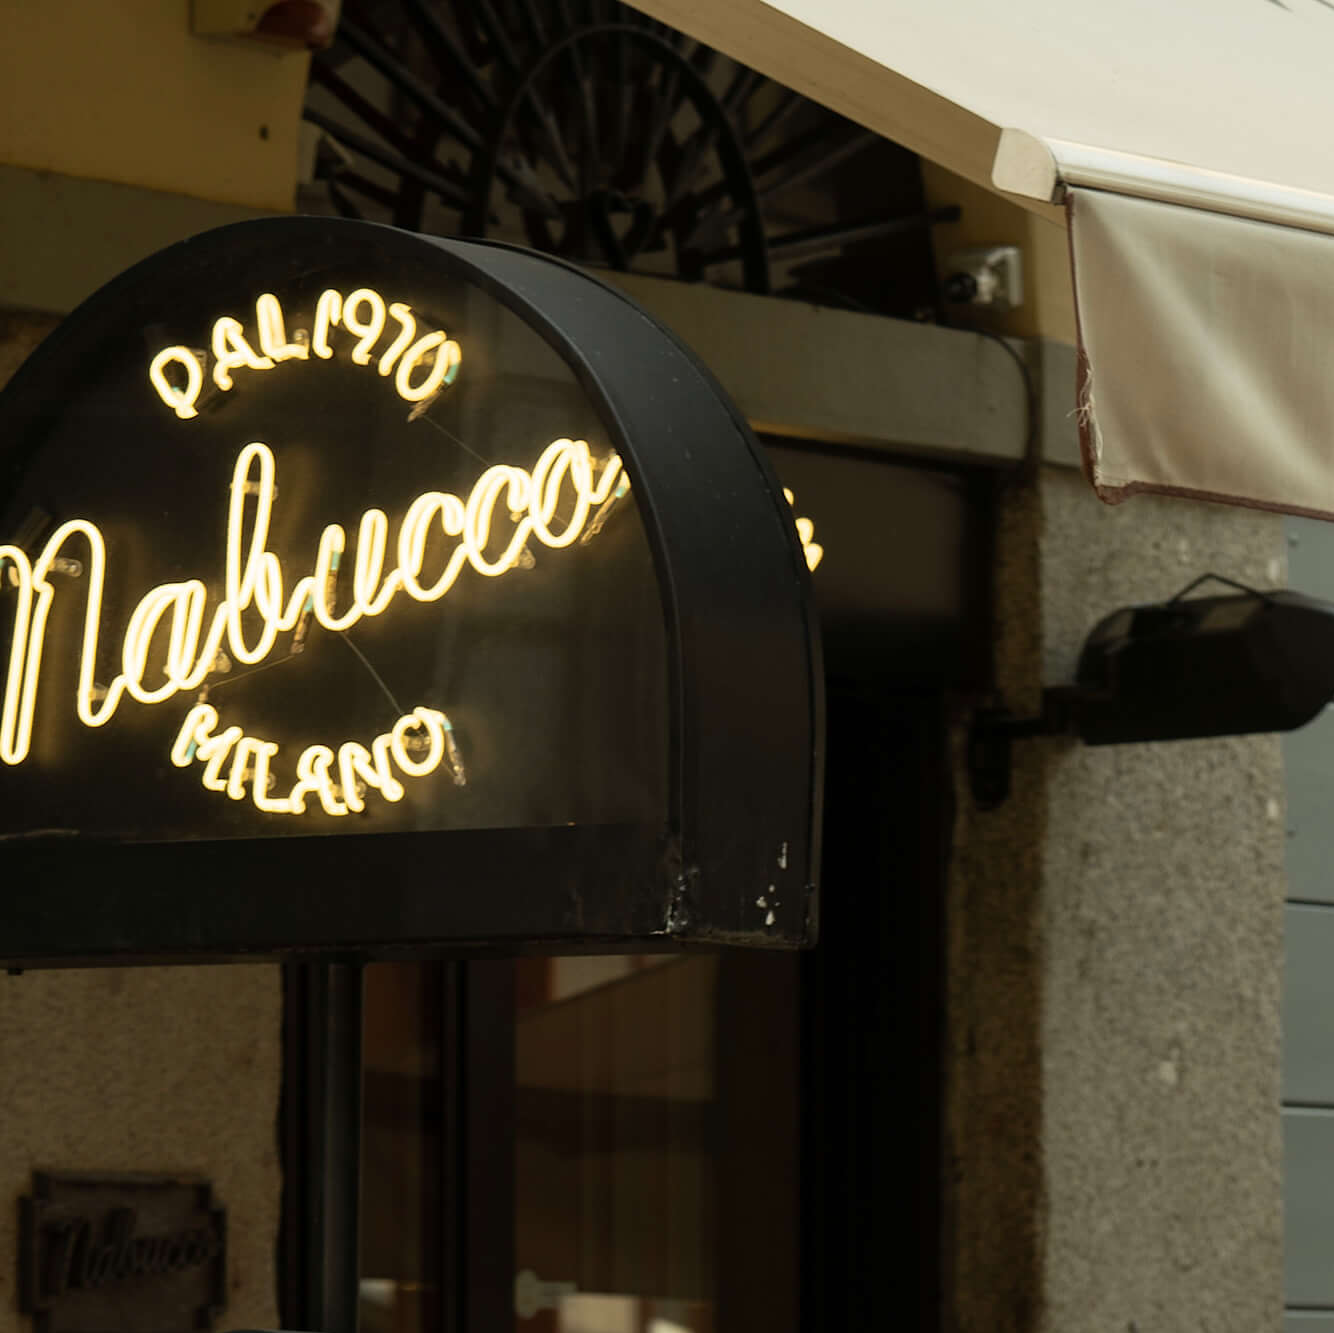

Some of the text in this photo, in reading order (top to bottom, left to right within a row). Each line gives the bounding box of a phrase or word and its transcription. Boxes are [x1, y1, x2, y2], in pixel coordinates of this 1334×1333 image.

[313, 288, 462, 402] 1970
[0, 441, 630, 765] Nabucco
[170, 703, 447, 816] MILANO
